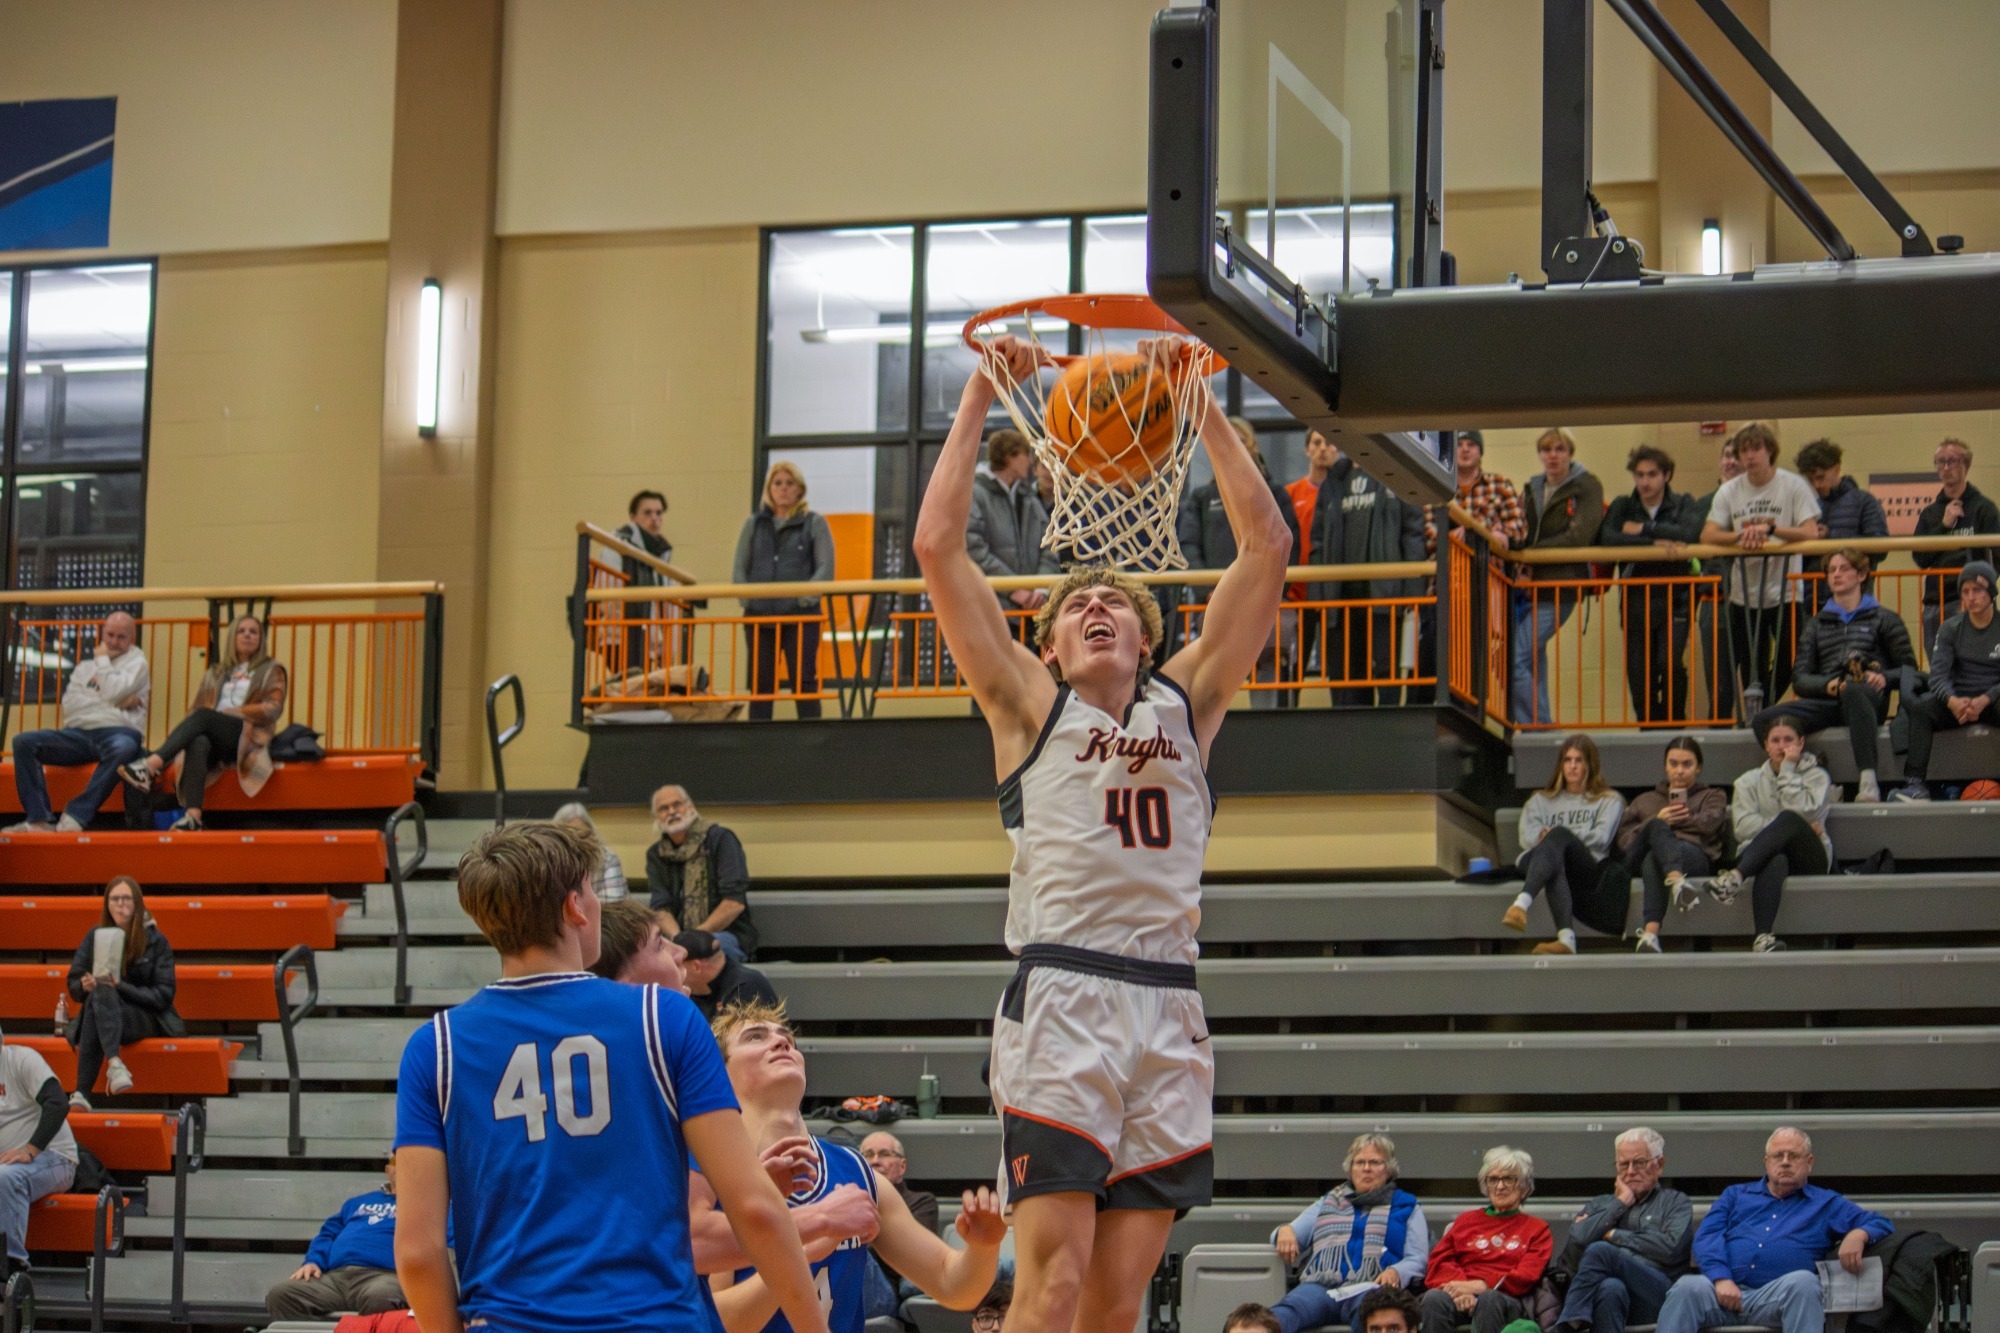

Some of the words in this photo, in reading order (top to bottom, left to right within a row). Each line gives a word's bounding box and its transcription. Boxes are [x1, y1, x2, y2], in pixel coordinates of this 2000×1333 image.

[1879, 496, 1933, 506] VISITO
[1105, 785, 1172, 850] 40
[1568, 809, 1598, 825] VEGA
[492, 1034, 612, 1143] 40
[1011, 1153, 1030, 1188] W
